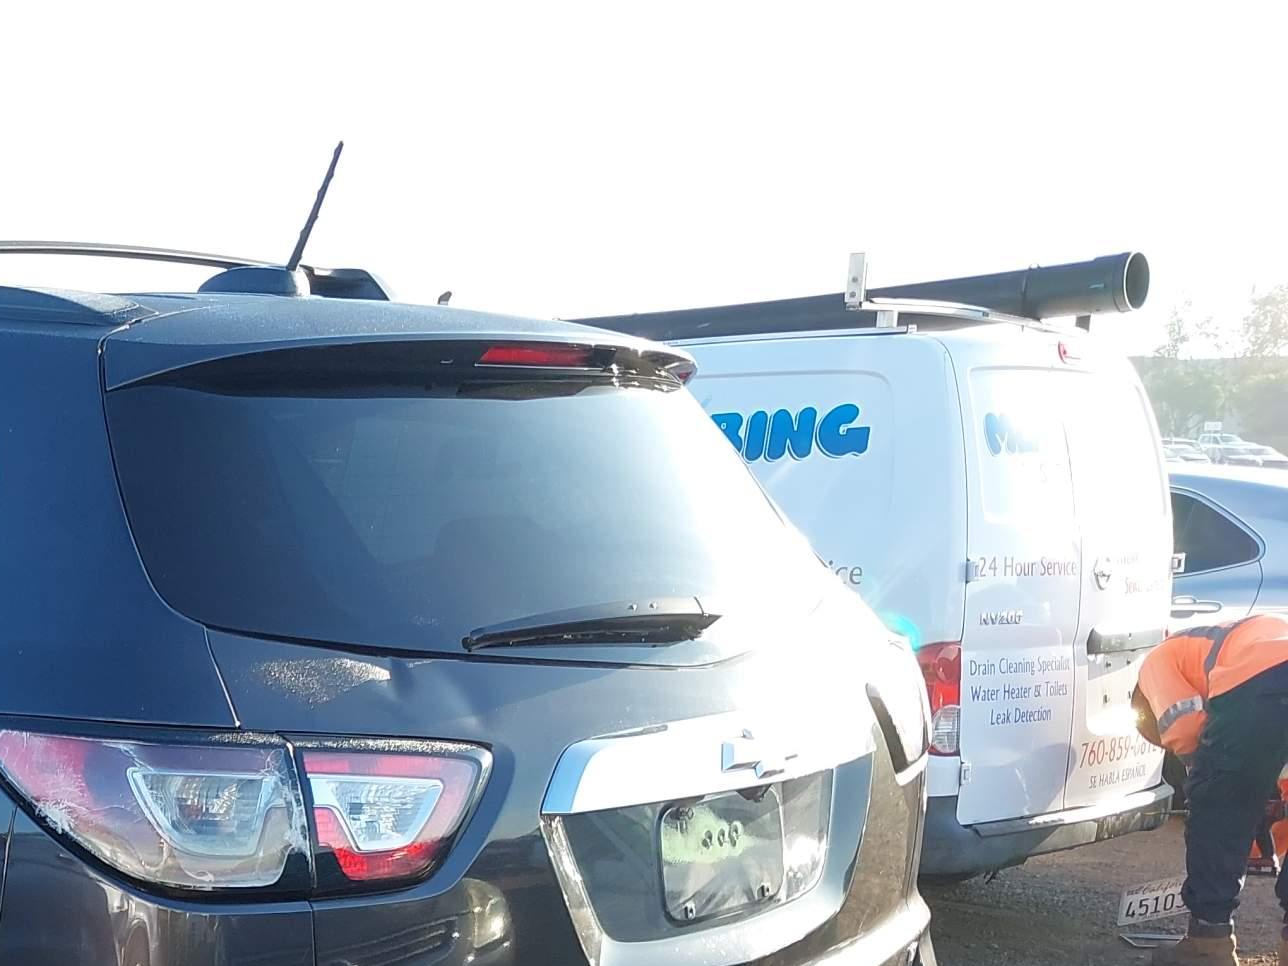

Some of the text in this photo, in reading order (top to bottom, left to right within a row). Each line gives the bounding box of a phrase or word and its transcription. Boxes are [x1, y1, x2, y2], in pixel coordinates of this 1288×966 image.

[979, 556, 1077, 577] 24 Hour Service
[969, 659, 996, 676] Drain
[998, 657, 1036, 676] Cleaning
[970, 680, 1069, 702] Water Heater & Toilets
[990, 706, 1052, 725] Leak Detection
[1088, 775, 1098, 789] SE
[1099, 770, 1120, 787] HABLA
